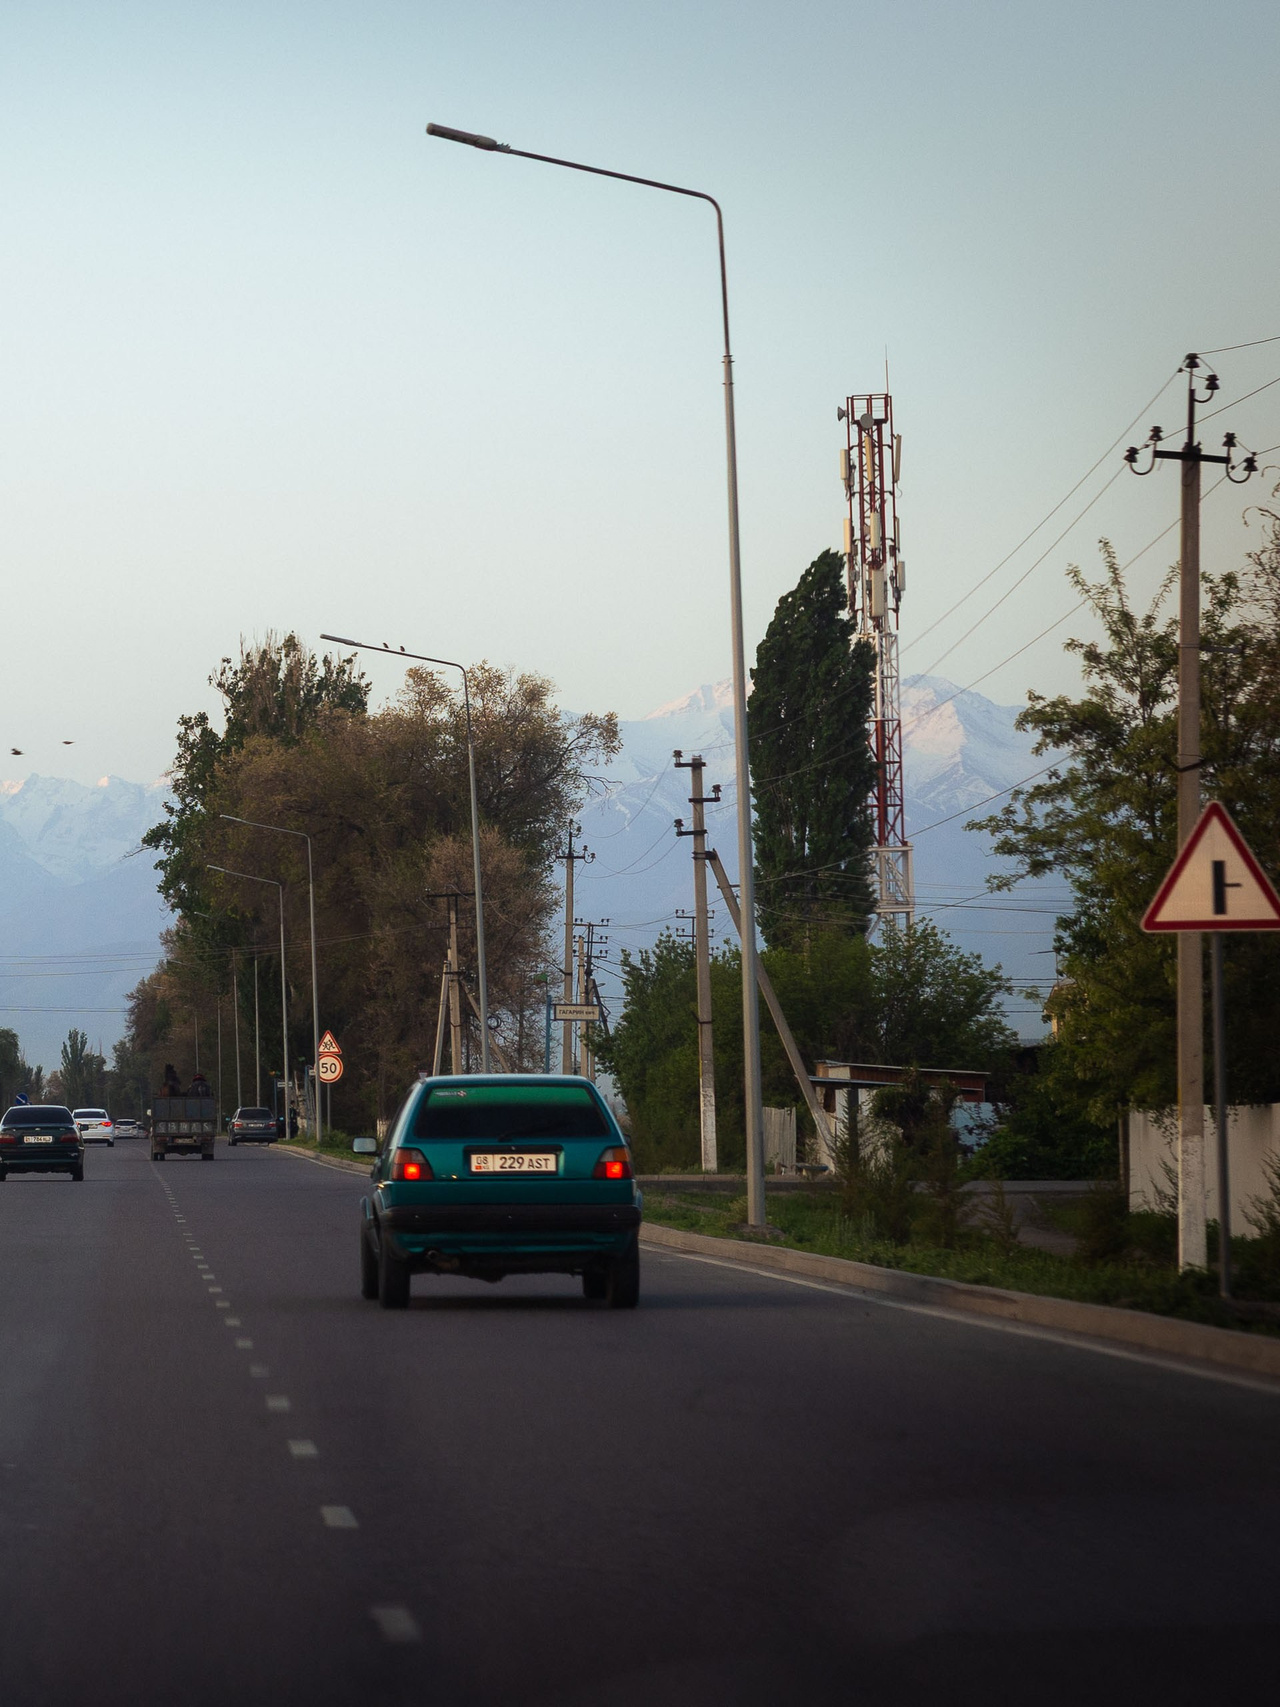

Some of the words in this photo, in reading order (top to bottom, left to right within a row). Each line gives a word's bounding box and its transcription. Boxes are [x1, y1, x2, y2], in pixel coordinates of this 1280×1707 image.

[321, 1062, 337, 1074] 50
[499, 1156, 525, 1169] 229
[527, 1158, 550, 1169] AST
